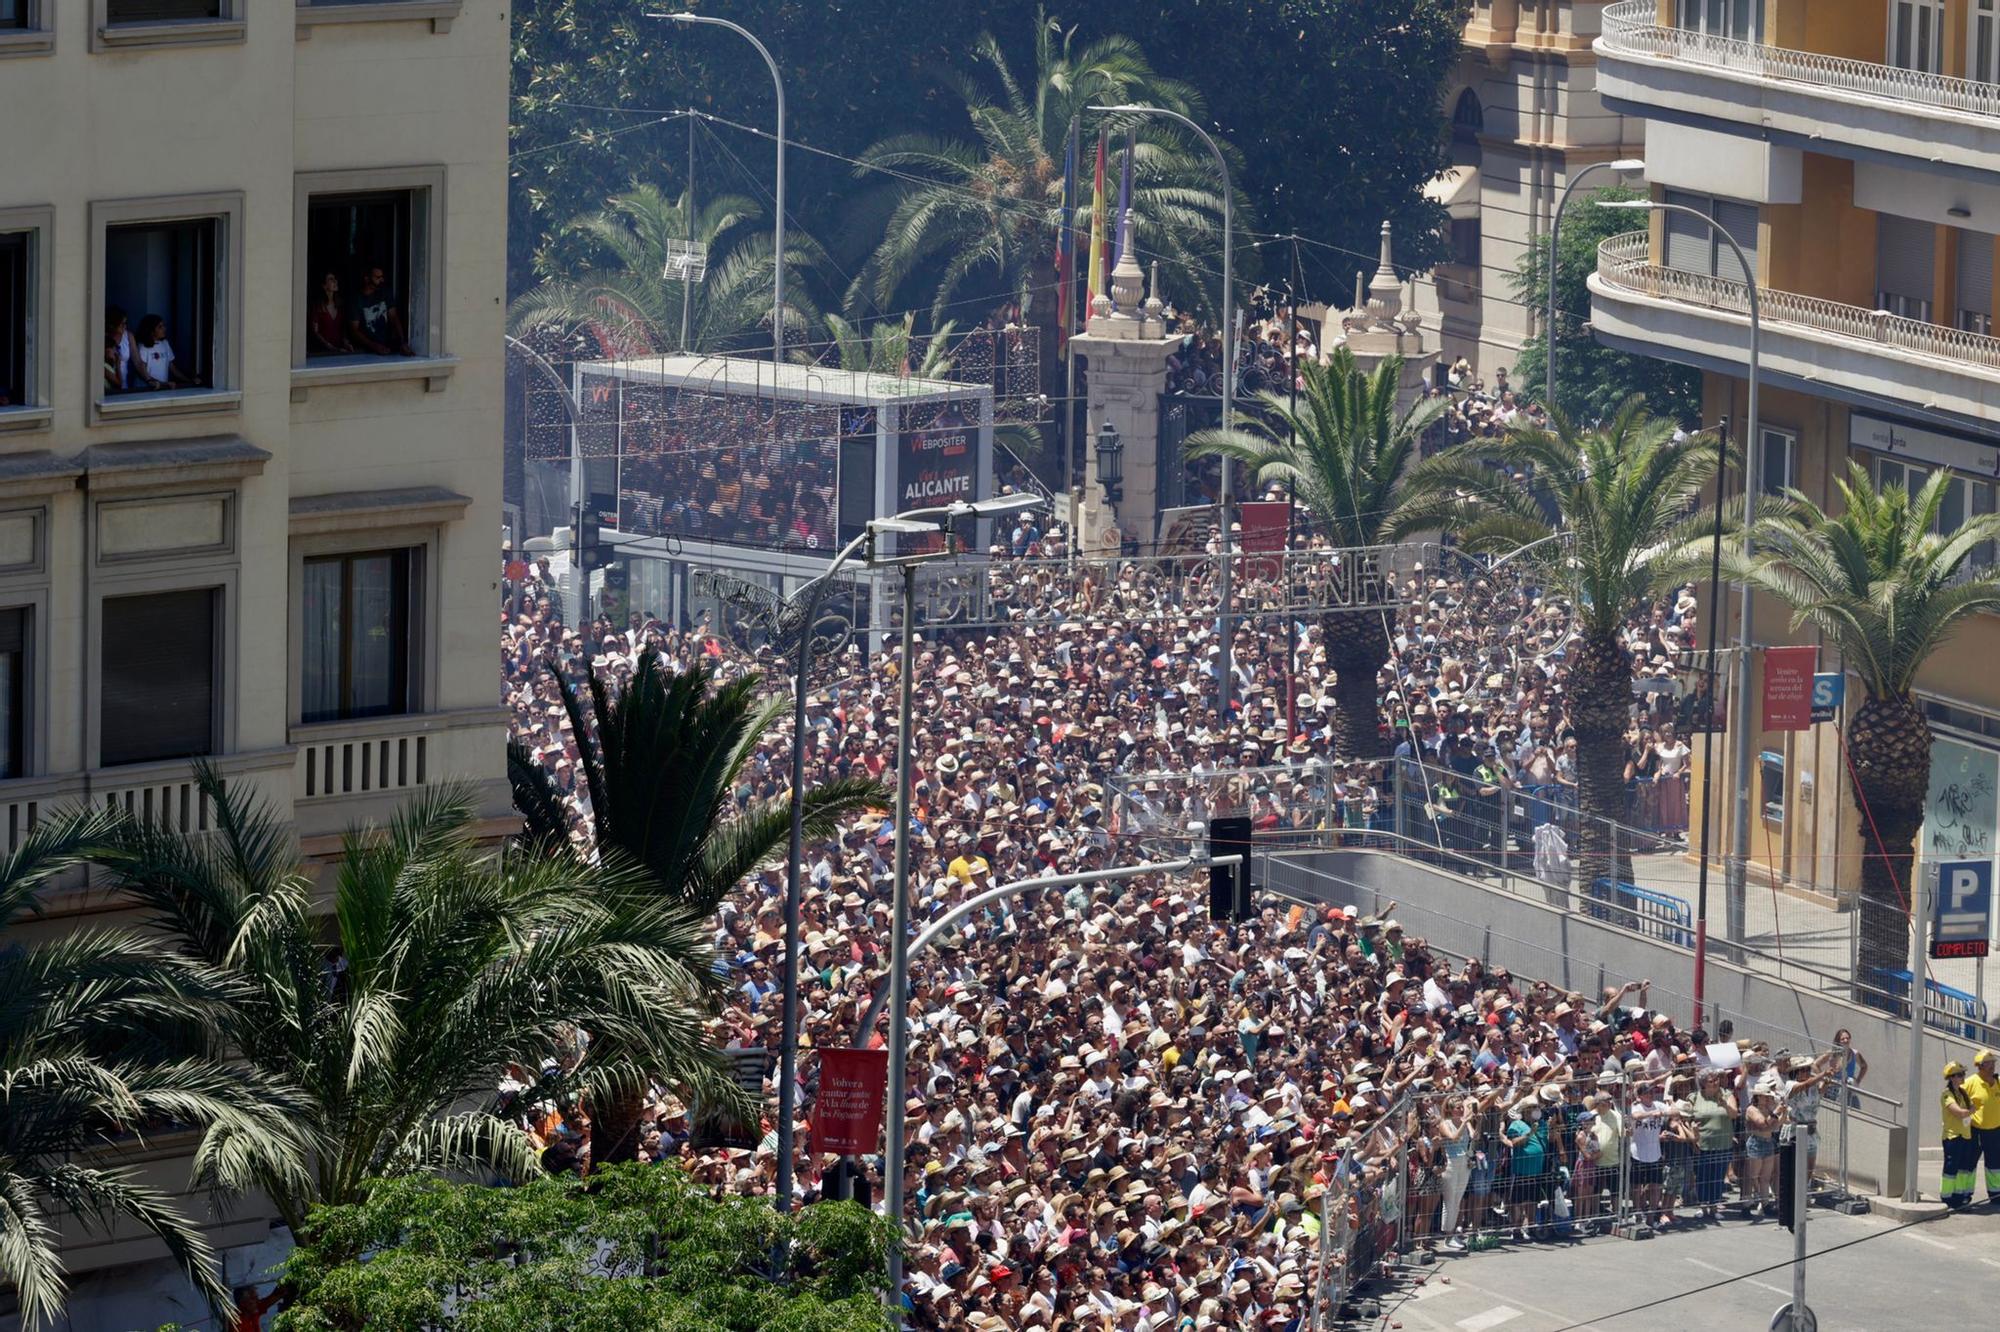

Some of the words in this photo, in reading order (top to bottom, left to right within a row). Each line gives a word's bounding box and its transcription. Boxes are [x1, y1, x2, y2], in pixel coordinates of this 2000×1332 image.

[911, 435, 967, 453] WEBPOSITER
[905, 476, 970, 500] ALICANTE
[1814, 680, 1833, 706] S
[1952, 869, 1979, 908] P
[1936, 942, 1986, 956] COMPLETO
[832, 1077, 857, 1088] Volver
[820, 1090, 847, 1098] cantar
[831, 1098, 838, 1108] la
[858, 1099, 870, 1109] de
[820, 1108, 831, 1118] les
